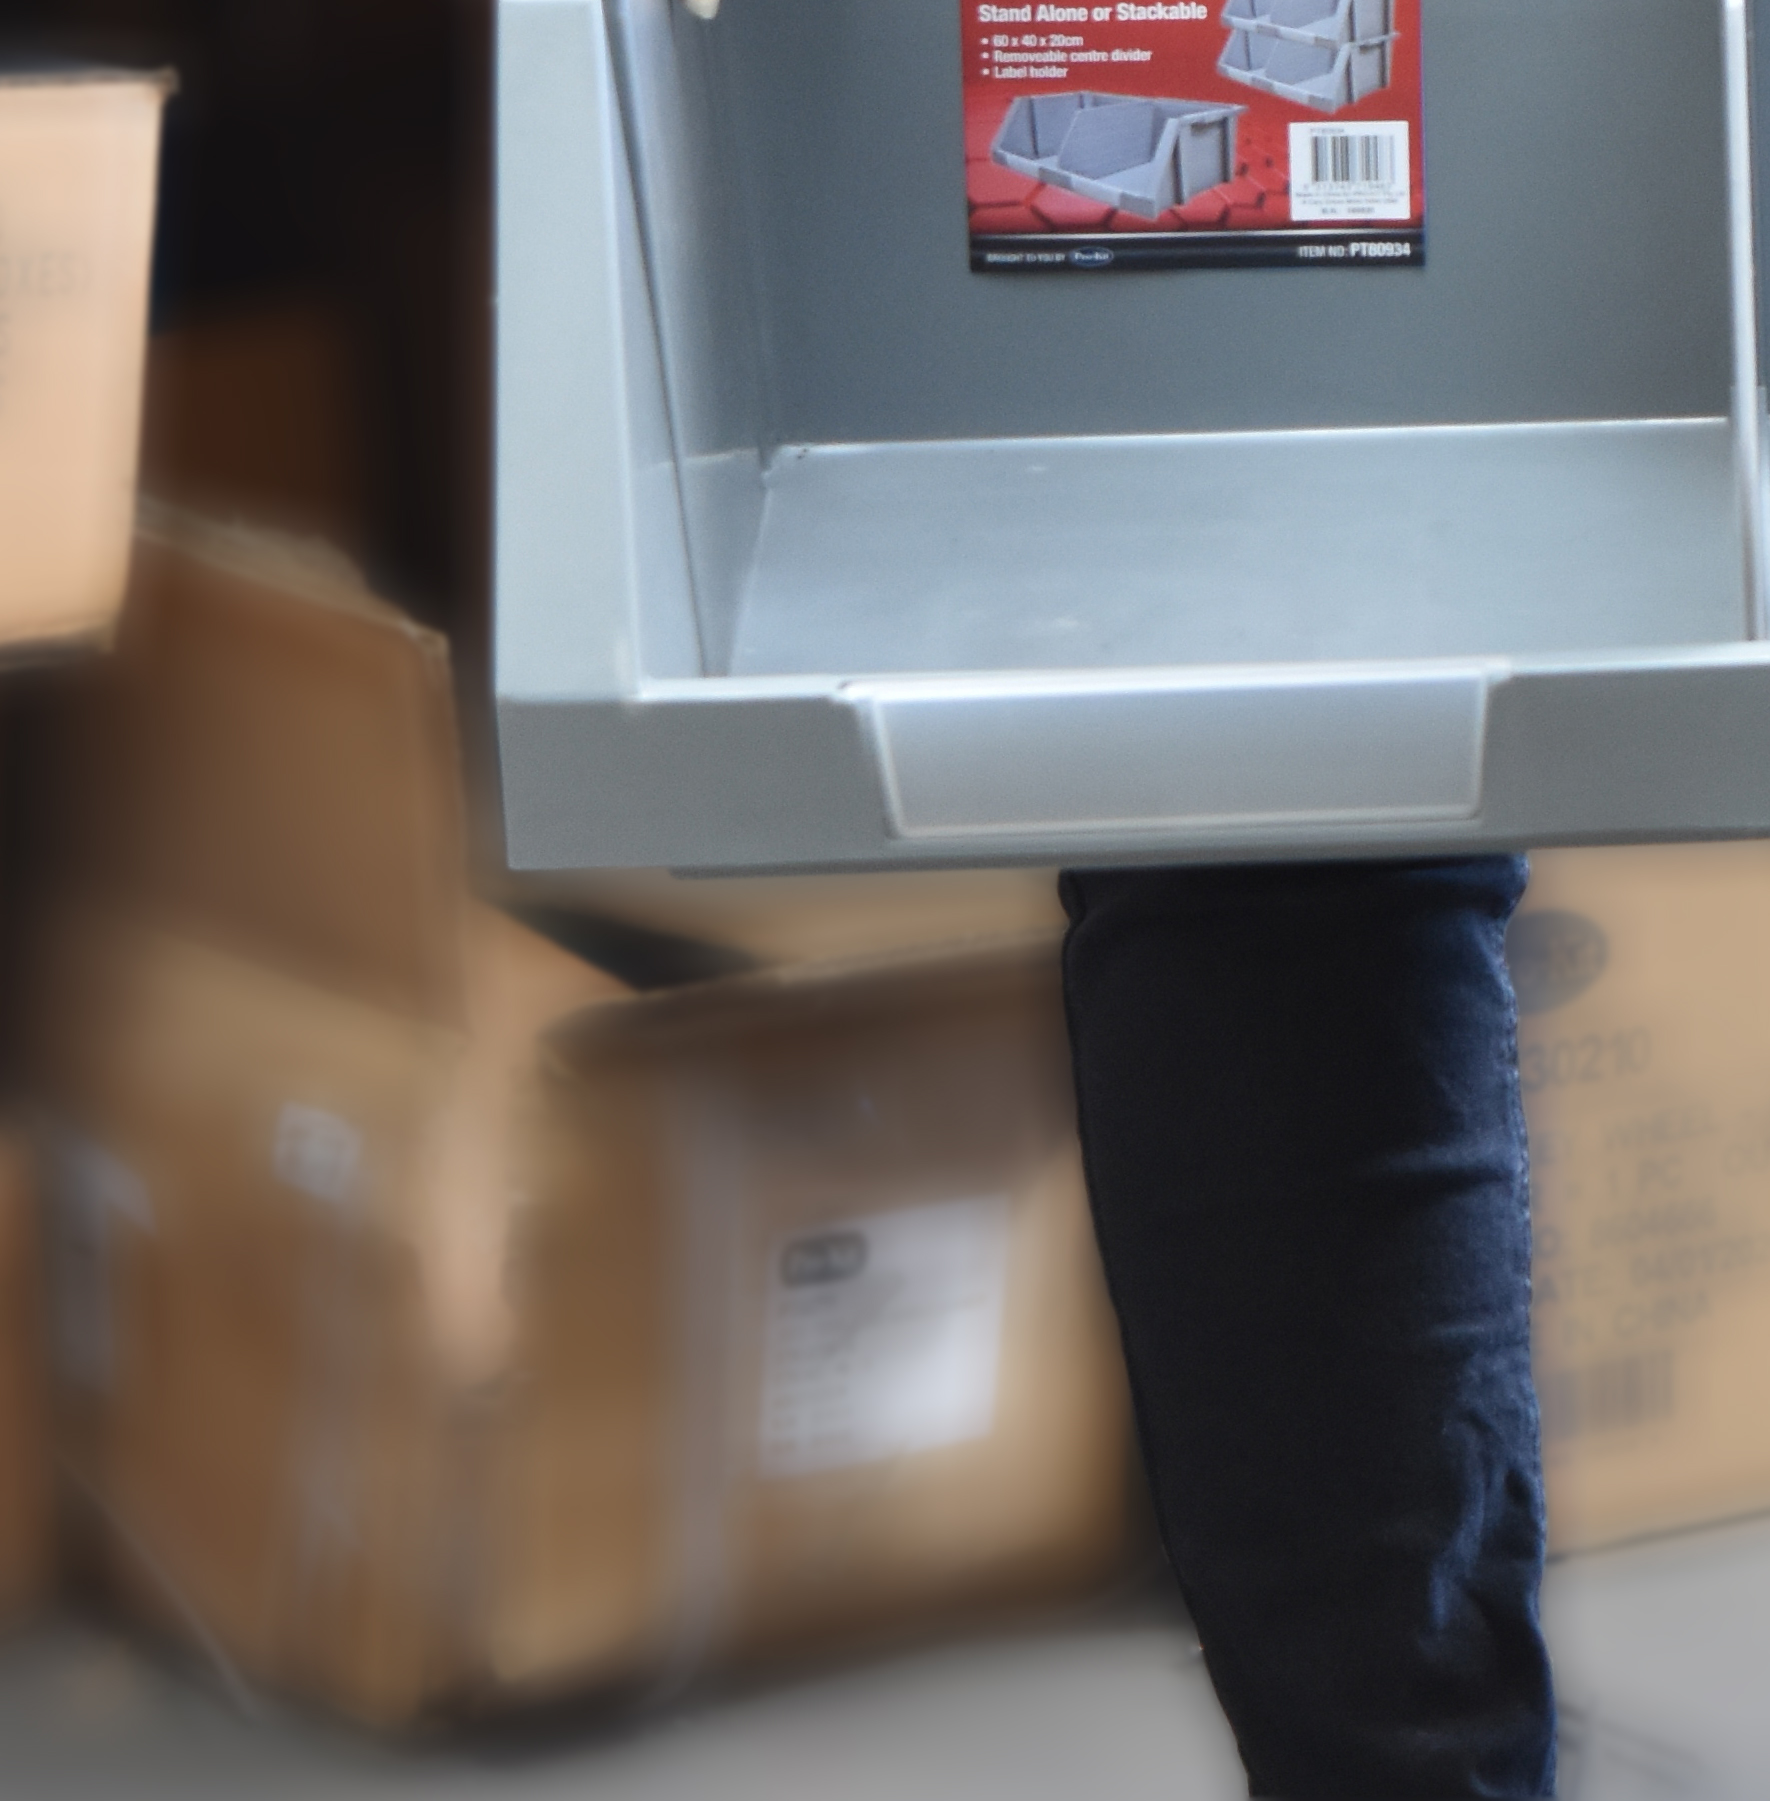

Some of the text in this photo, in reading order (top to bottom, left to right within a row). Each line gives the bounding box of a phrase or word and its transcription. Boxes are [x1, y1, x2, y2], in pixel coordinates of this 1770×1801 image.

[978, 1, 1208, 22] Stand Alone or Stackable
[1011, 38, 1019, 47] x
[1021, 34, 1037, 47] 40
[1039, 38, 1047, 47] x
[993, 47, 1153, 63] Removeable centre divider
[993, 64, 1068, 79] Label holder
[1298, 245, 1326, 258] ITEM
